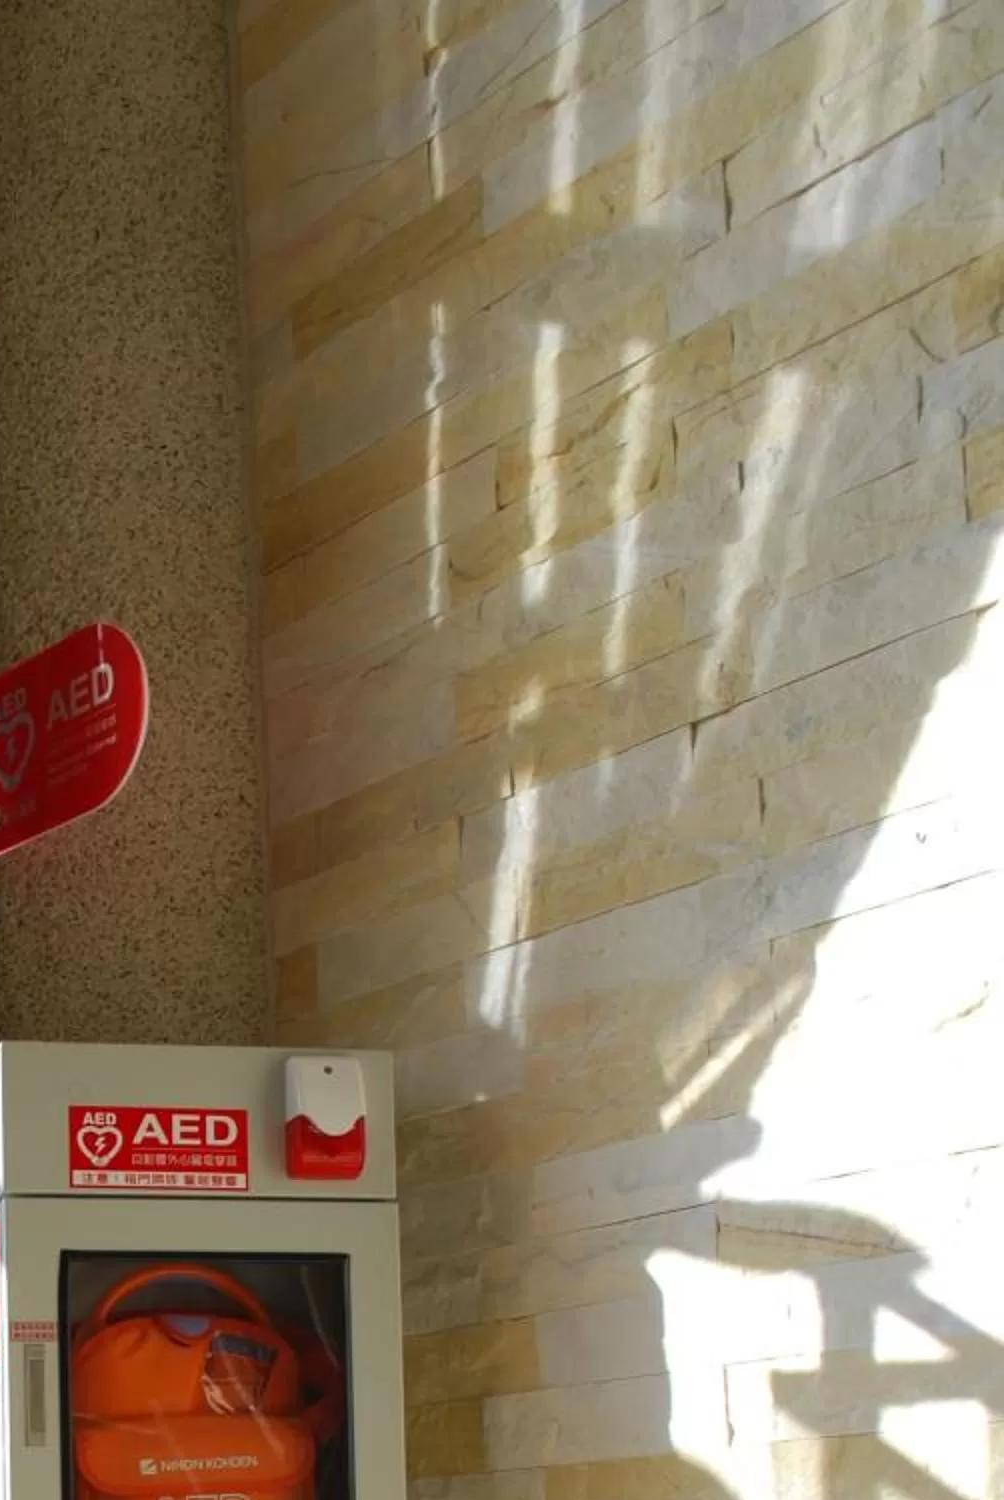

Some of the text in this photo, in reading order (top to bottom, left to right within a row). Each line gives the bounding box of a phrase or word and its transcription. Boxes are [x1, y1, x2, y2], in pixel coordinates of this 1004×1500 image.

[47, 662, 115, 728] AED
[82, 1111, 117, 1126] AED
[131, 1113, 239, 1147] AED
